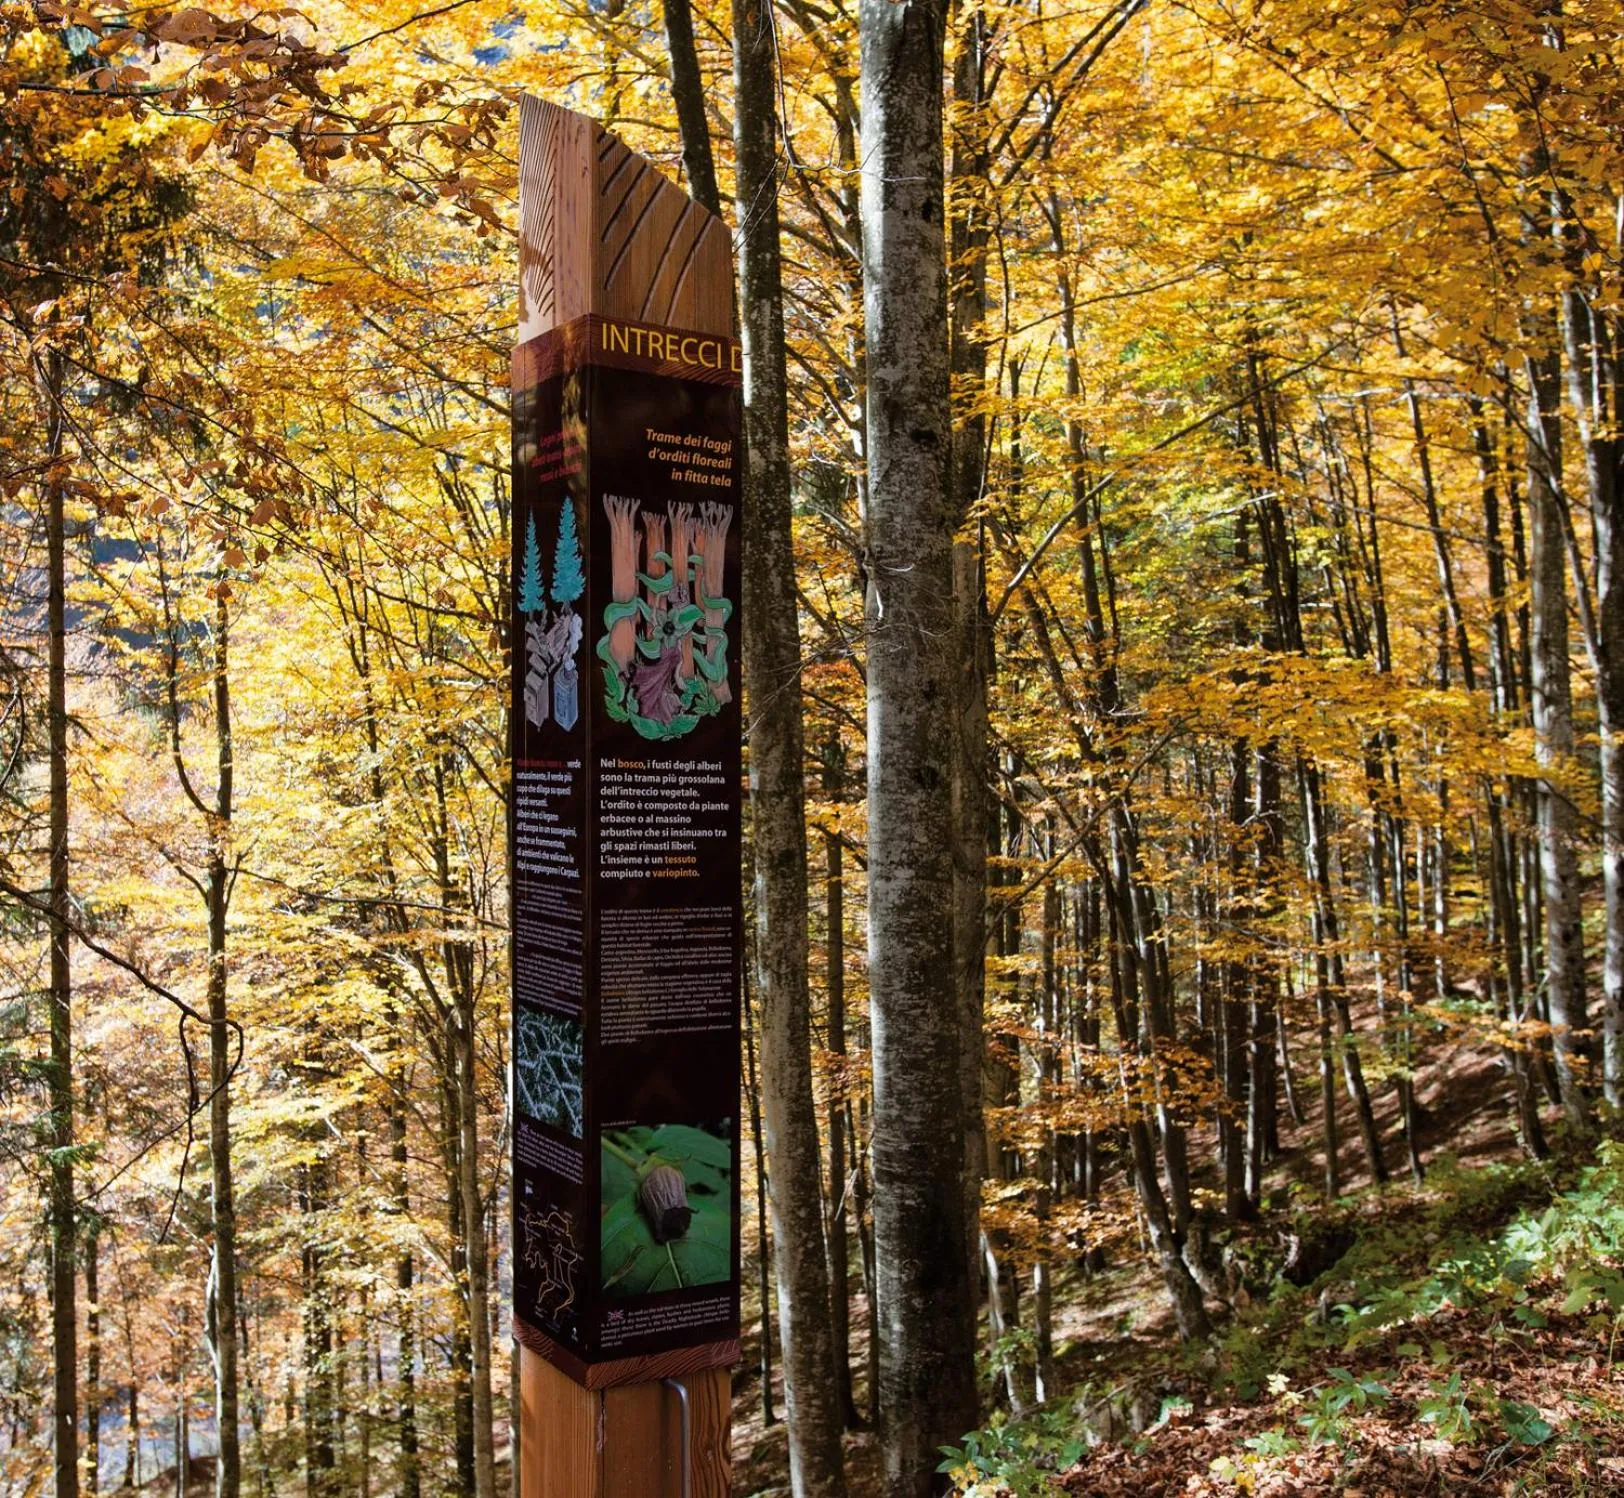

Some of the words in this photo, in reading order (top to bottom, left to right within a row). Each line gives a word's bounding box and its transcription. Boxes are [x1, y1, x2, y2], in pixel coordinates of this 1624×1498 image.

[602, 322, 722, 369] INTRECCI
[646, 428, 682, 445] Trame
[683, 434, 701, 447] dei
[702, 436, 733, 455] faggi
[648, 447, 691, 464] d'orditi
[692, 453, 733, 470] floreali
[671, 468, 683, 481] in
[684, 470, 709, 485] fitta
[710, 475, 732, 488] tela
[600, 758, 616, 768] Nel
[617, 759, 646, 770] bosco,
[647, 760, 651, 769] i
[652, 760, 672, 769] fusti
[673, 760, 695, 772] degli
[697, 761, 722, 771] alberi
[600, 774, 621, 782] sono
[624, 772, 632, 782] la
[635, 774, 660, 782] trama
[662, 774, 677, 785] più
[679, 775, 726, 785] grossolana
[600, 786, 659, 796] dell'intreccio
[660, 788, 700, 798] vegetale.
[600, 800, 636, 809] L'ordito
[637, 801, 643, 809] è
[644, 802, 688, 812] composto
[689, 801, 701, 810] da
[702, 801, 730, 812] piante
[600, 814, 636, 823] erbacee
[645, 813, 654, 823] al
[655, 814, 692, 823] massino
[600, 828, 643, 837] arbustive
[644, 828, 660, 837] che
[662, 828, 669, 837] si
[670, 828, 714, 837] insinuano
[715, 828, 728, 837] tra
[600, 841, 612, 852] gli
[614, 841, 637, 852] spazi
[639, 841, 670, 850] rimasti
[671, 841, 697, 850] liberi.
[600, 855, 642, 864] L'insieme
[644, 855, 651, 864] è
[664, 855, 697, 864] tessuto
[600, 868, 644, 879] compiuto
[652, 868, 700, 879] variopinto.
